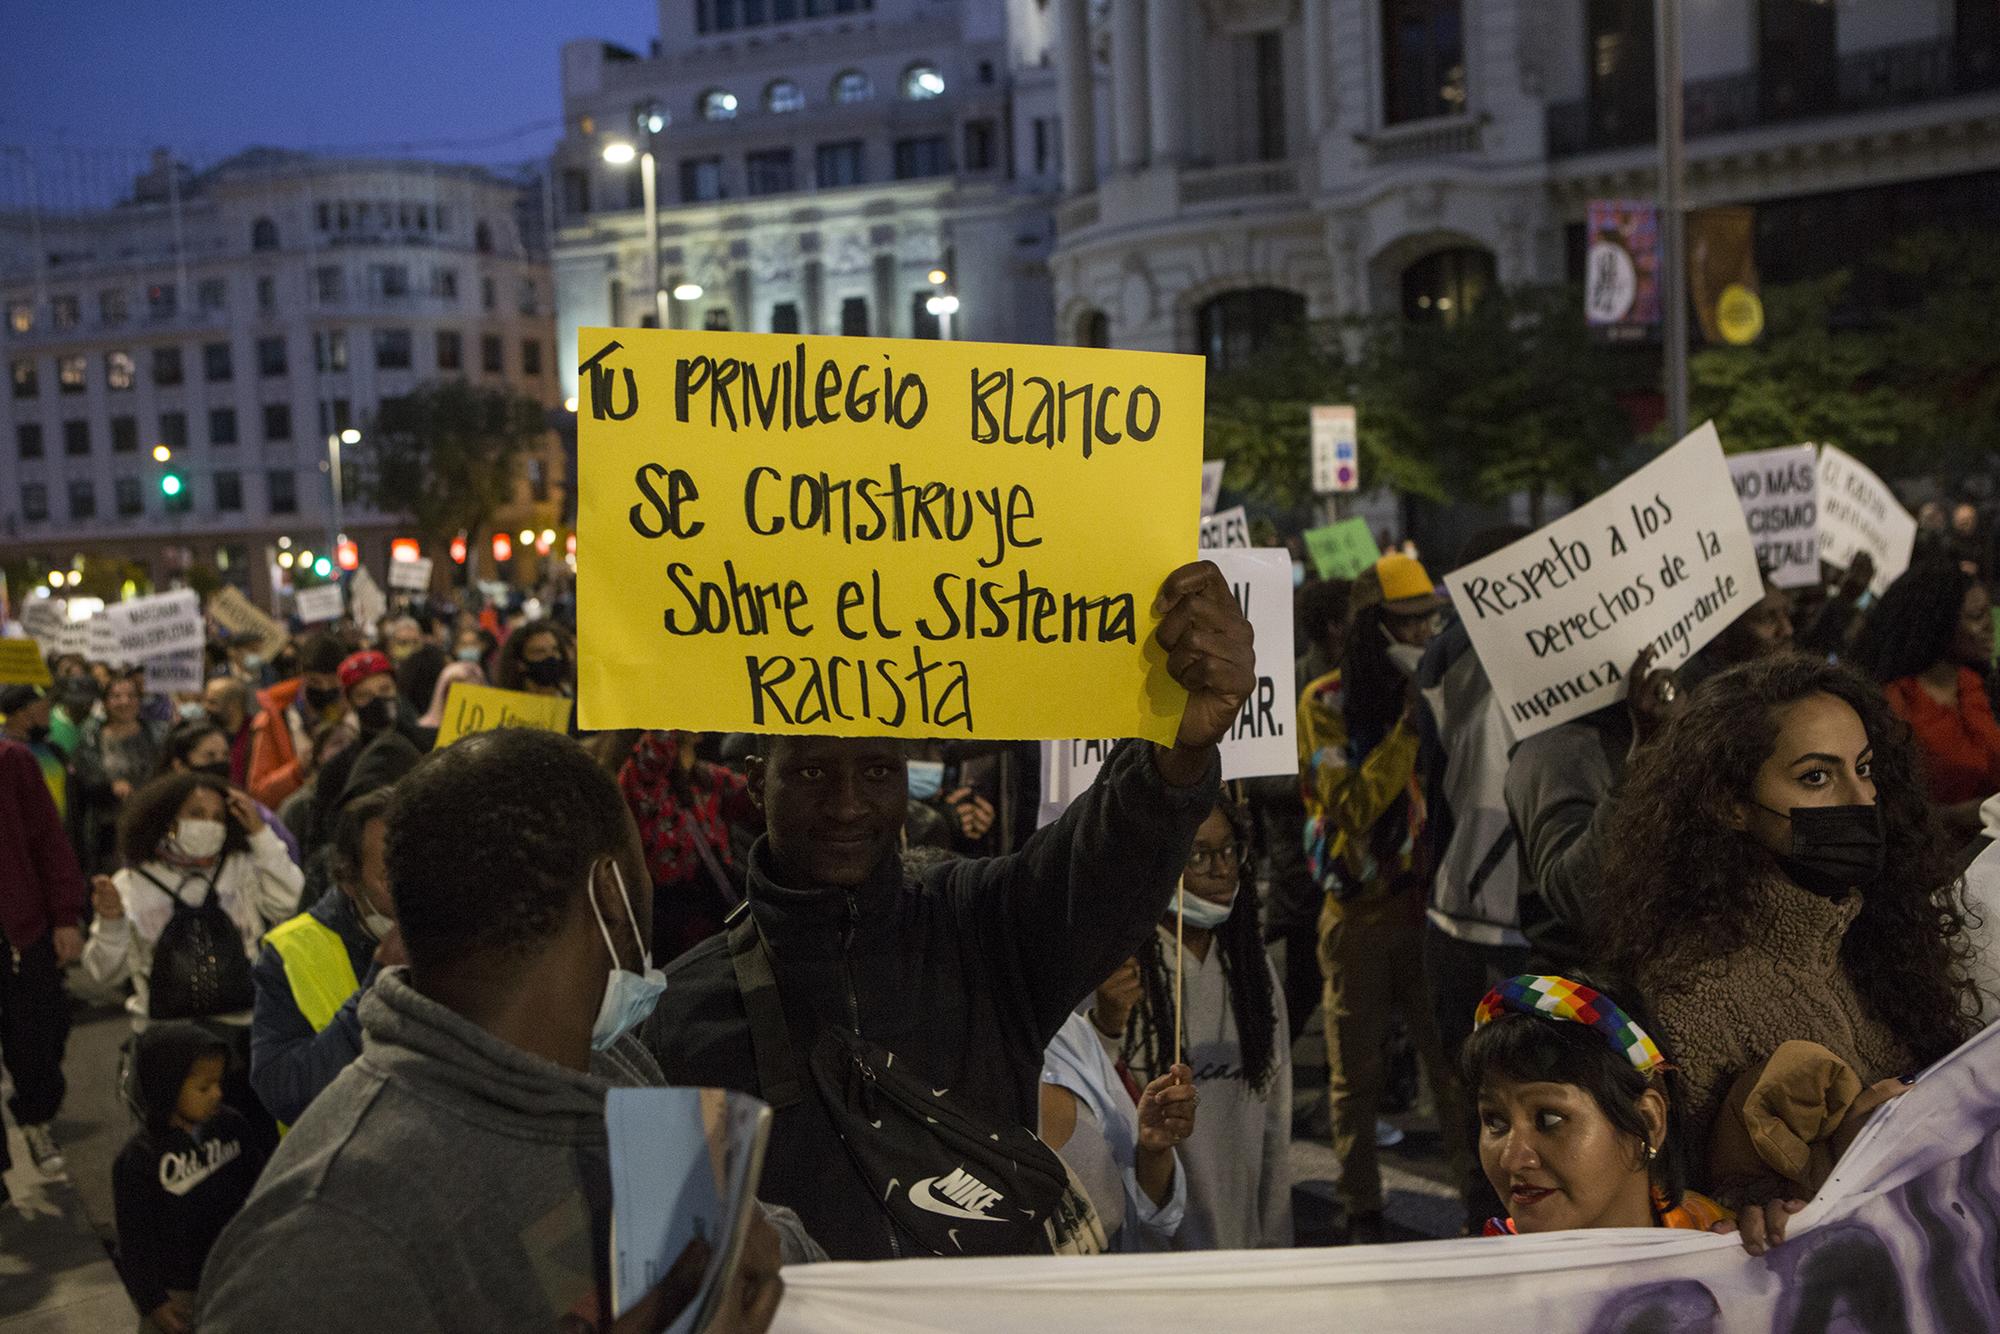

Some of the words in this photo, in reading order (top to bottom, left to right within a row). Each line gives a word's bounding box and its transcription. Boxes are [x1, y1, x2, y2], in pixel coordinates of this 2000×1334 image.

[1463, 536, 1592, 619] Respeto
[1630, 493, 1673, 540] los
[1659, 553, 1690, 588] de
[1696, 530, 1722, 563] la
[837, 570, 902, 640] el
[932, 1167, 1004, 1216] NIKE
